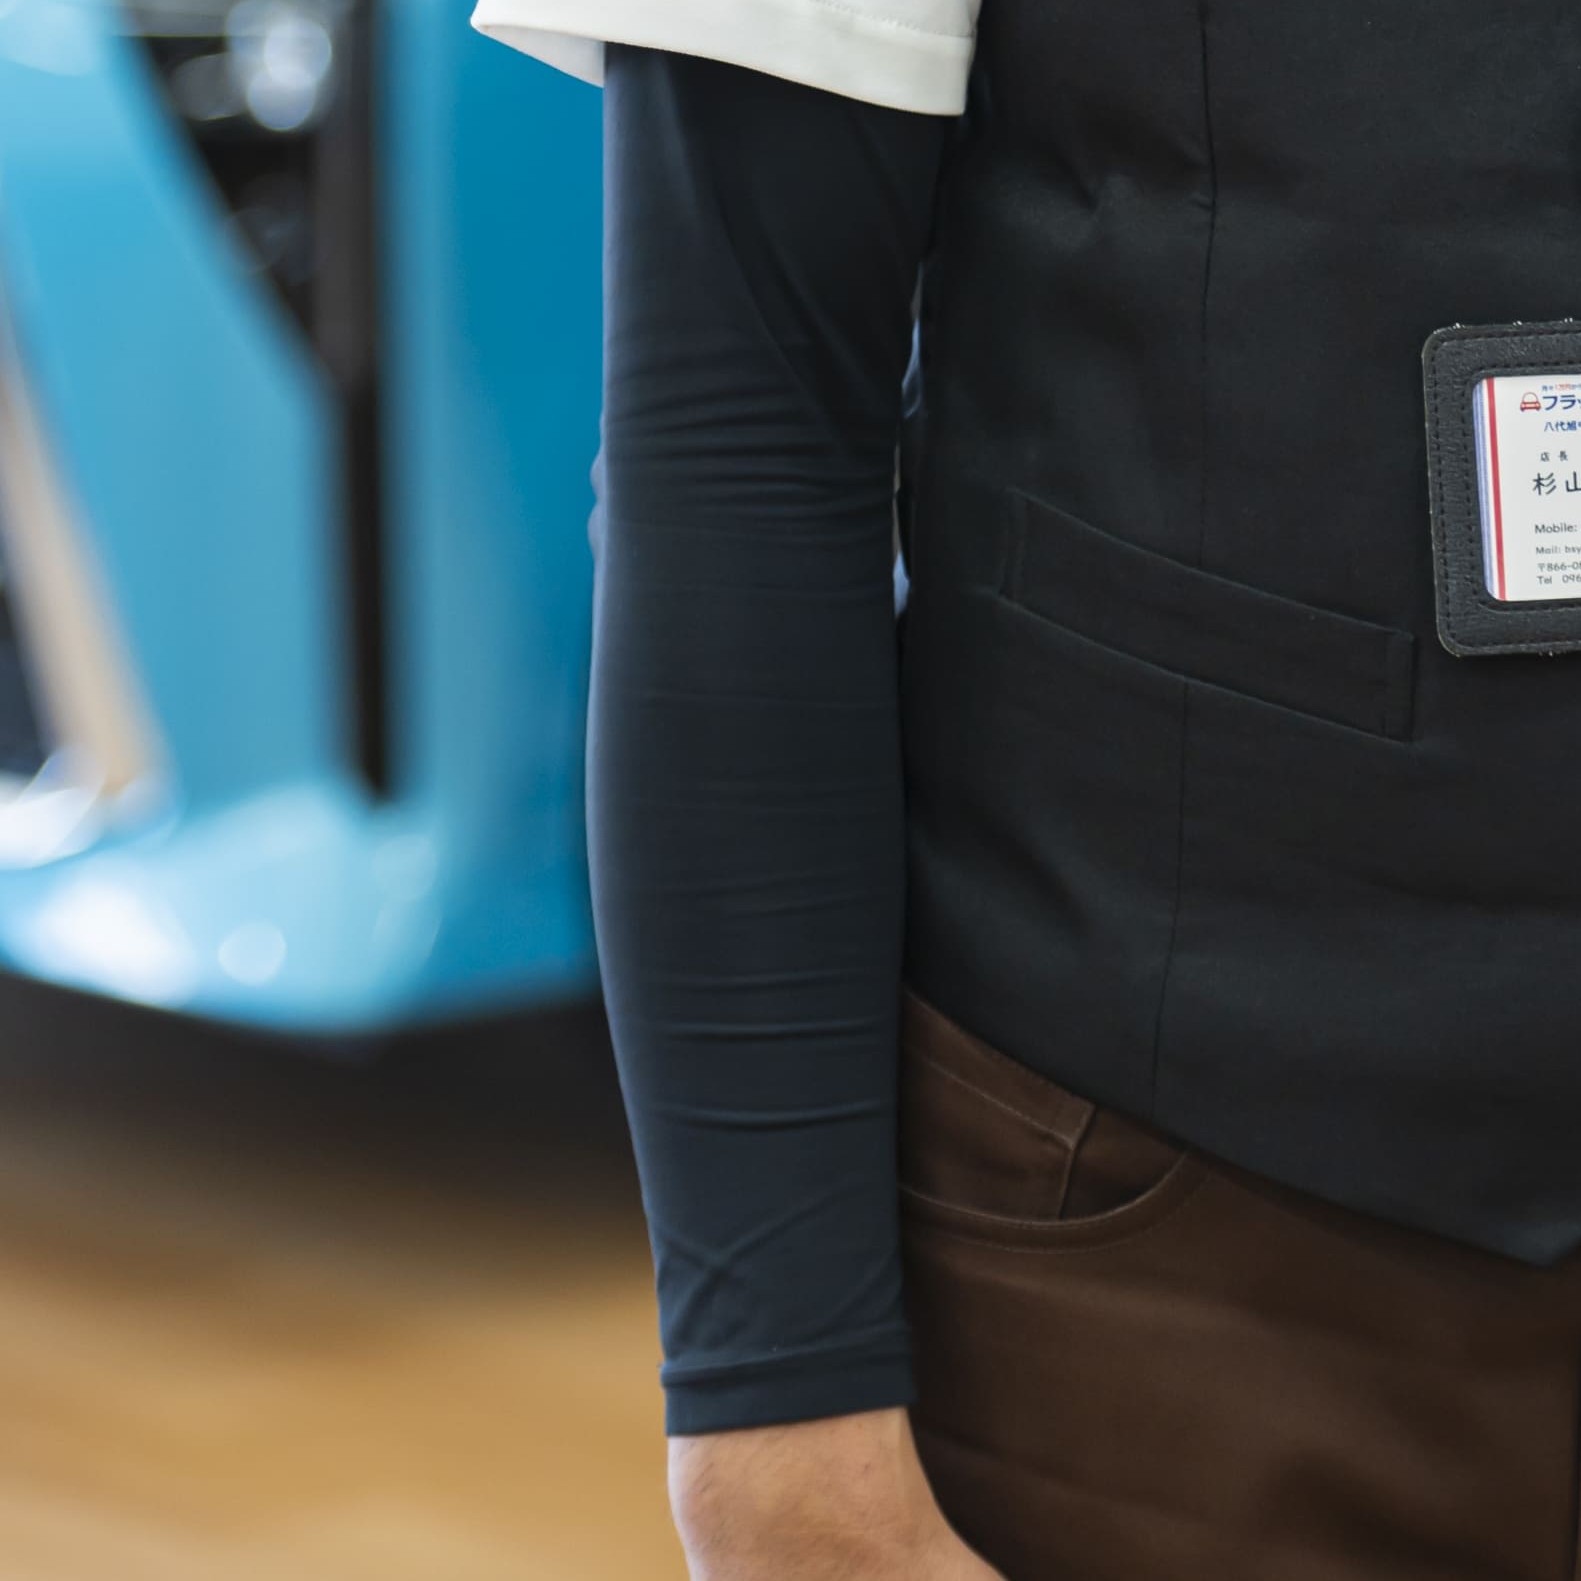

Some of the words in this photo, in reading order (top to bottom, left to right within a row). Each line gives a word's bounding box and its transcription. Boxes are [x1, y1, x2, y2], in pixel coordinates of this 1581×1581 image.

[1534, 523, 1578, 534] Mobile:
[1535, 545, 1562, 555] Mail:
[1536, 576, 1553, 585] Tel
